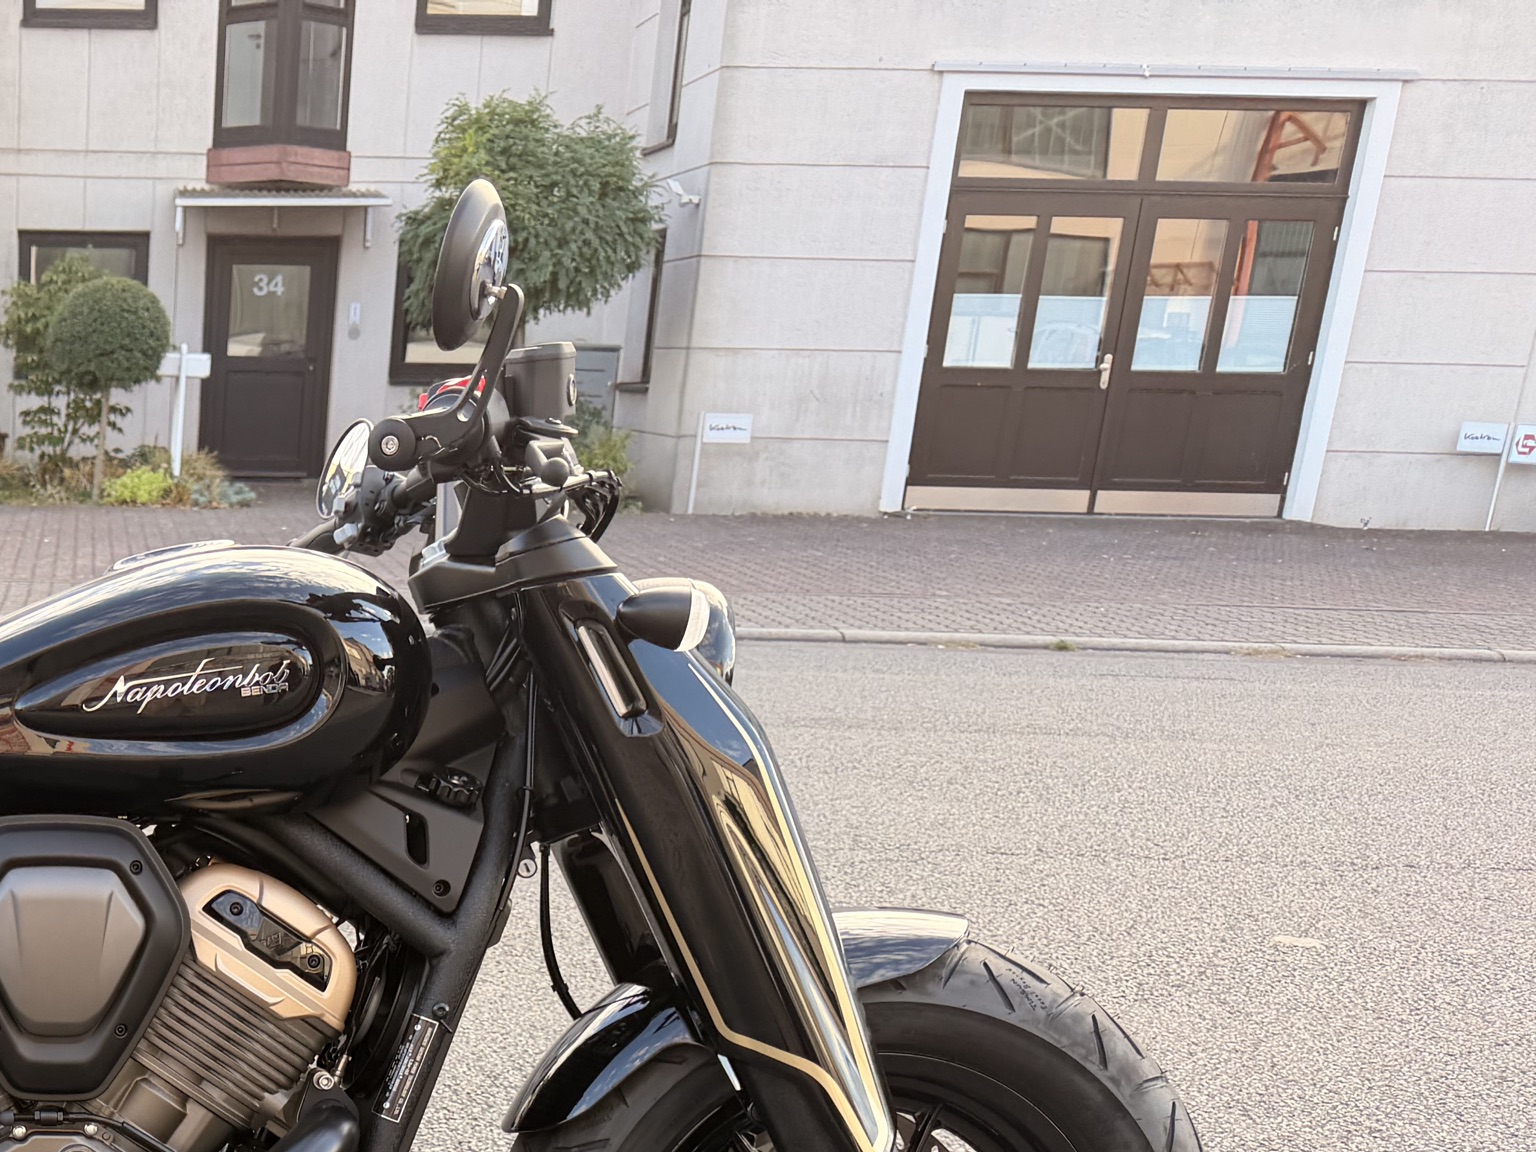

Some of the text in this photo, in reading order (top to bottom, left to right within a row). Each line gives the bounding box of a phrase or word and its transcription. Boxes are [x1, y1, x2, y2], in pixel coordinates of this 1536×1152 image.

[252, 273, 285, 297] 34
[82, 657, 291, 715] Napoleonbob
[239, 682, 289, 698] BENDA
